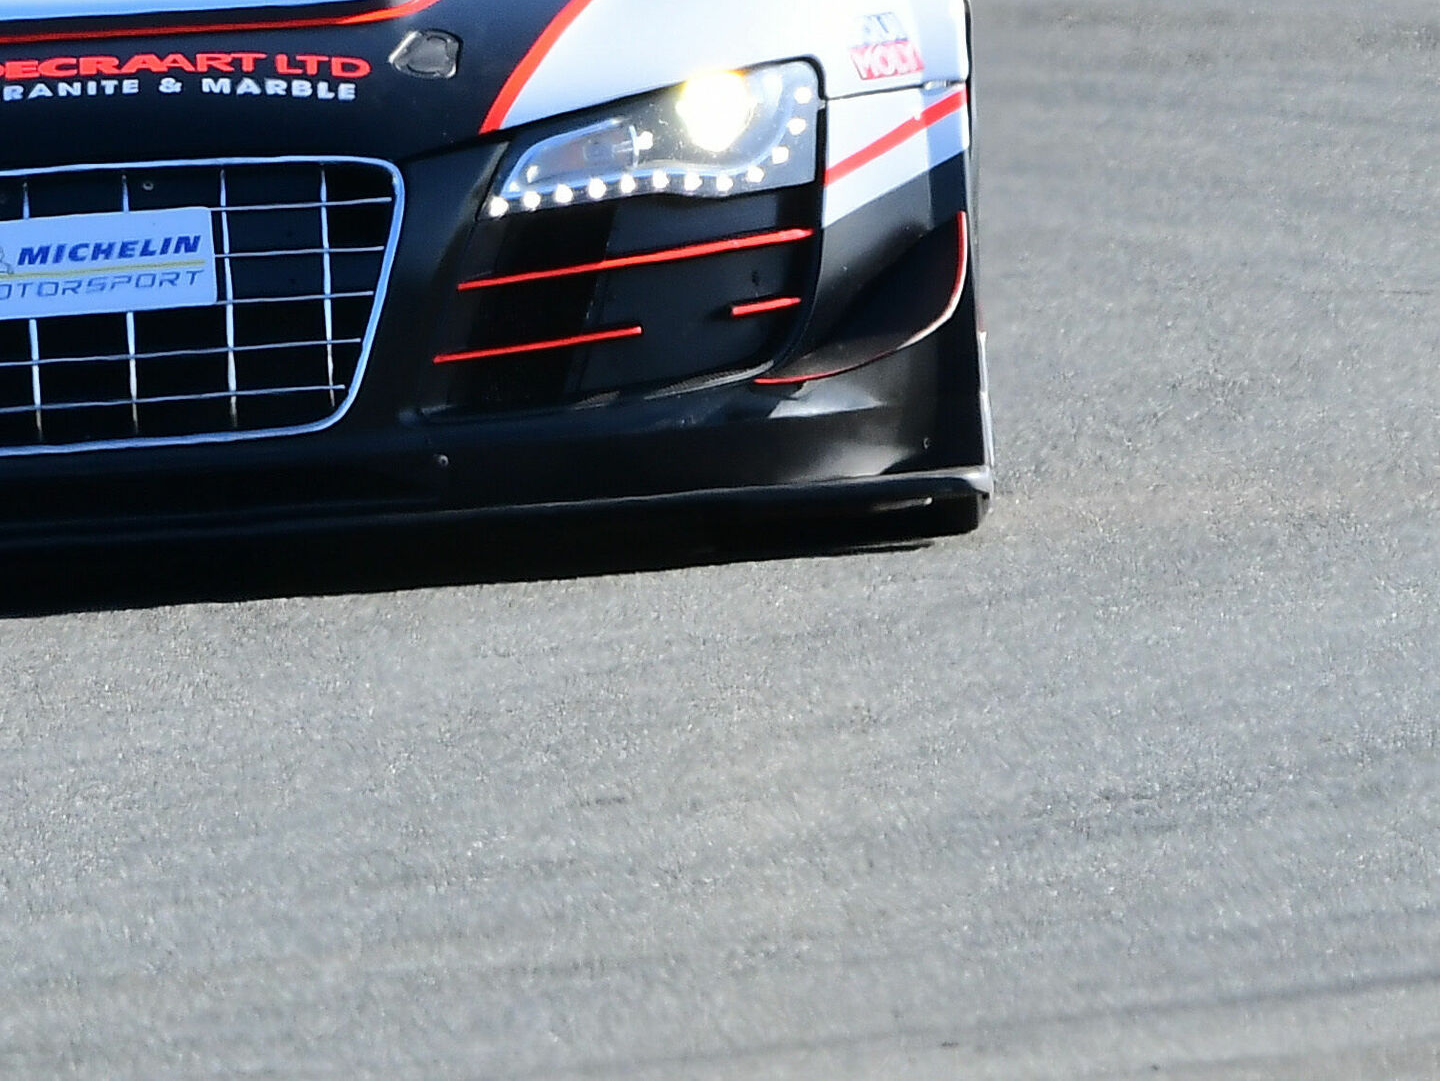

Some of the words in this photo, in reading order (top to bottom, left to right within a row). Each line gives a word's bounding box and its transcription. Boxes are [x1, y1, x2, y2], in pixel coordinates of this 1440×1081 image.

[275, 54, 371, 78] LTD
[159, 78, 182, 93] &
[202, 78, 357, 100] MARBLE
[17, 235, 201, 266] MICHELIN
